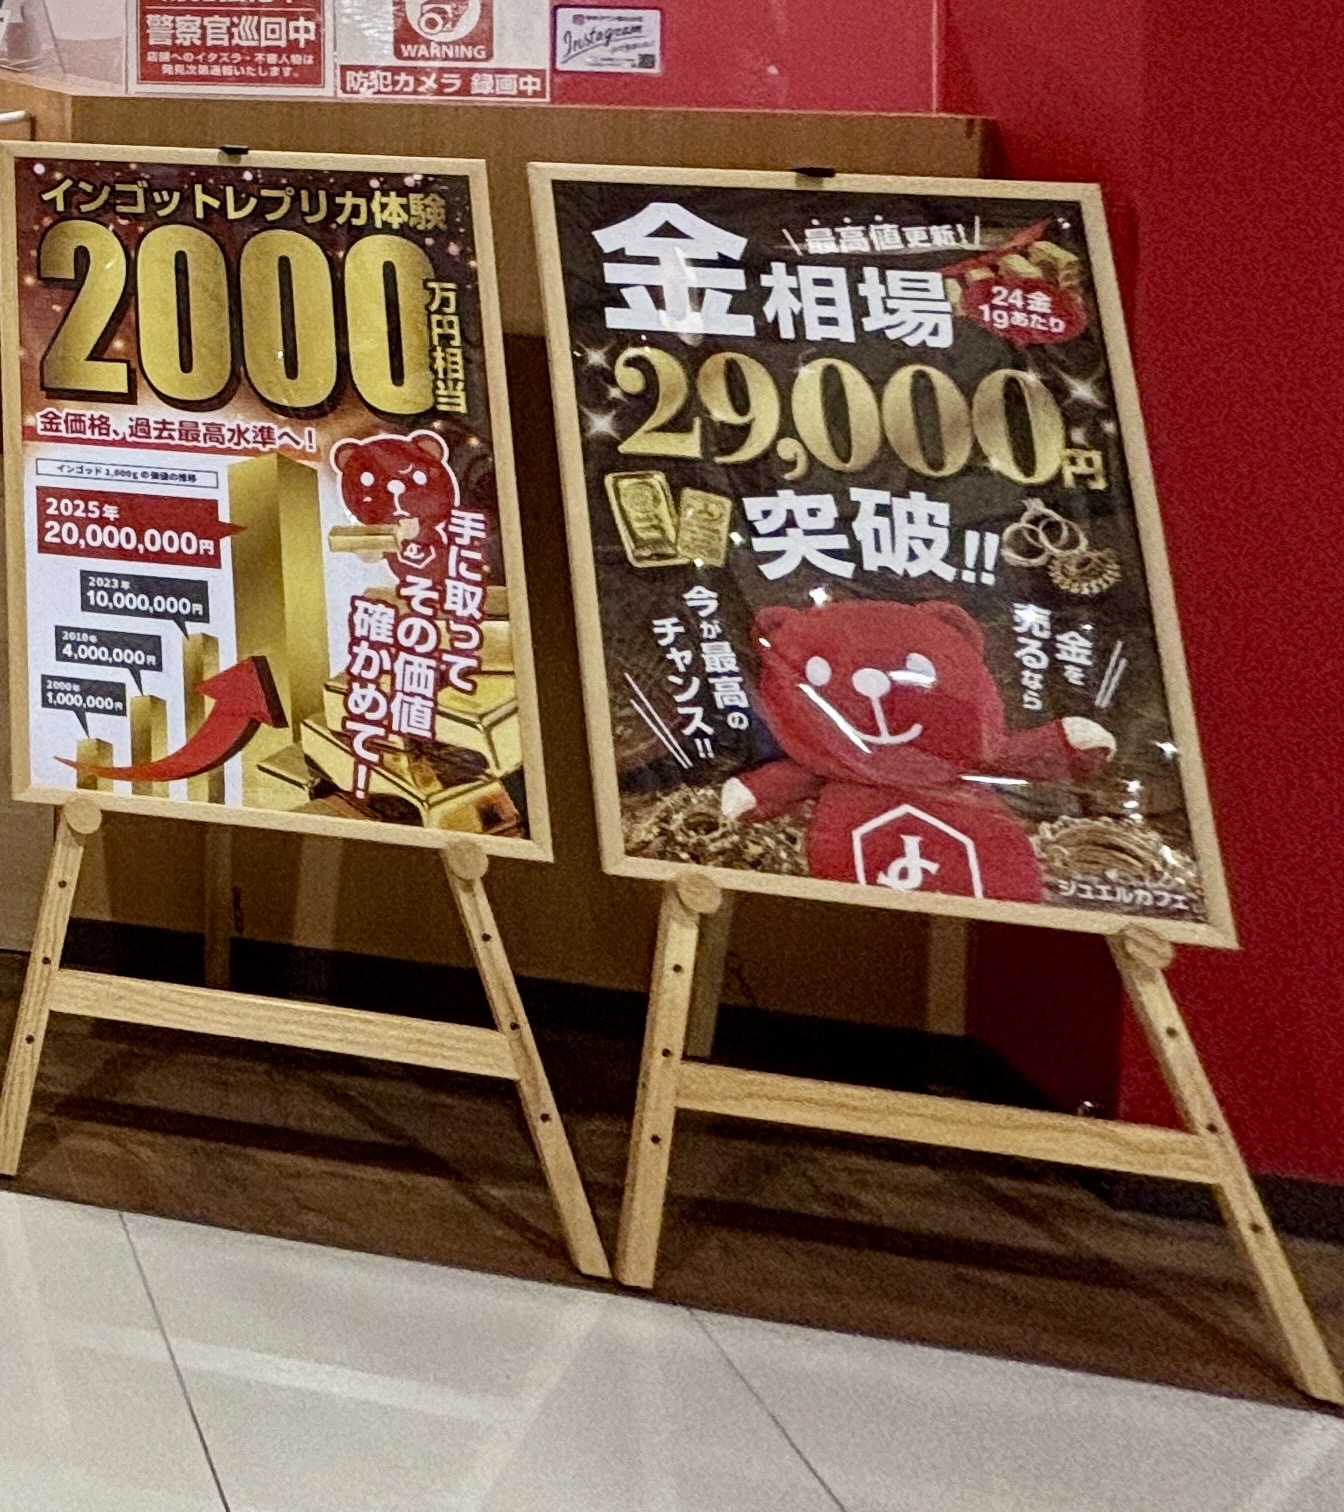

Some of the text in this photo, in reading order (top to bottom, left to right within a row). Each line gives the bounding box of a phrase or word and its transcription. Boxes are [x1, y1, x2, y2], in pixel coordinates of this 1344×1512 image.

[146, 14, 316, 48] 警察官巡回中
[563, 25, 643, 58] Instagram
[400, 42, 487, 59] WARNING
[346, 71, 542, 96] 防犯カメラ 録画中
[40, 177, 447, 231] インゴットレプリカ体験
[979, 304, 1066, 333] 1gあたり
[992, 286, 1052, 314] 24金
[40, 220, 438, 418] 2000
[426, 281, 467, 414] 万円相当
[38, 410, 317, 451] 金価格、過去最高水準へ！
[45, 498, 120, 521] 2025年
[44, 521, 214, 555] 20,000,000円
[743, 486, 999, 585] 突破!!
[87, 590, 203, 616] 10,000,000円
[442, 509, 486, 692] 手に取って
[62, 644, 156, 666] 4,000,000円
[391, 574, 439, 738] その価値
[682, 585, 750, 731] 今が最高の
[1012, 602, 1052, 710] 売るなら
[1055, 631, 1093, 686] 金を
[47, 692, 123, 711] 1,000,000円
[346, 600, 395, 800] 確かめて！
[651, 617, 714, 759] チャンス!!
[1058, 879, 1189, 910] ジュエルカフェ
